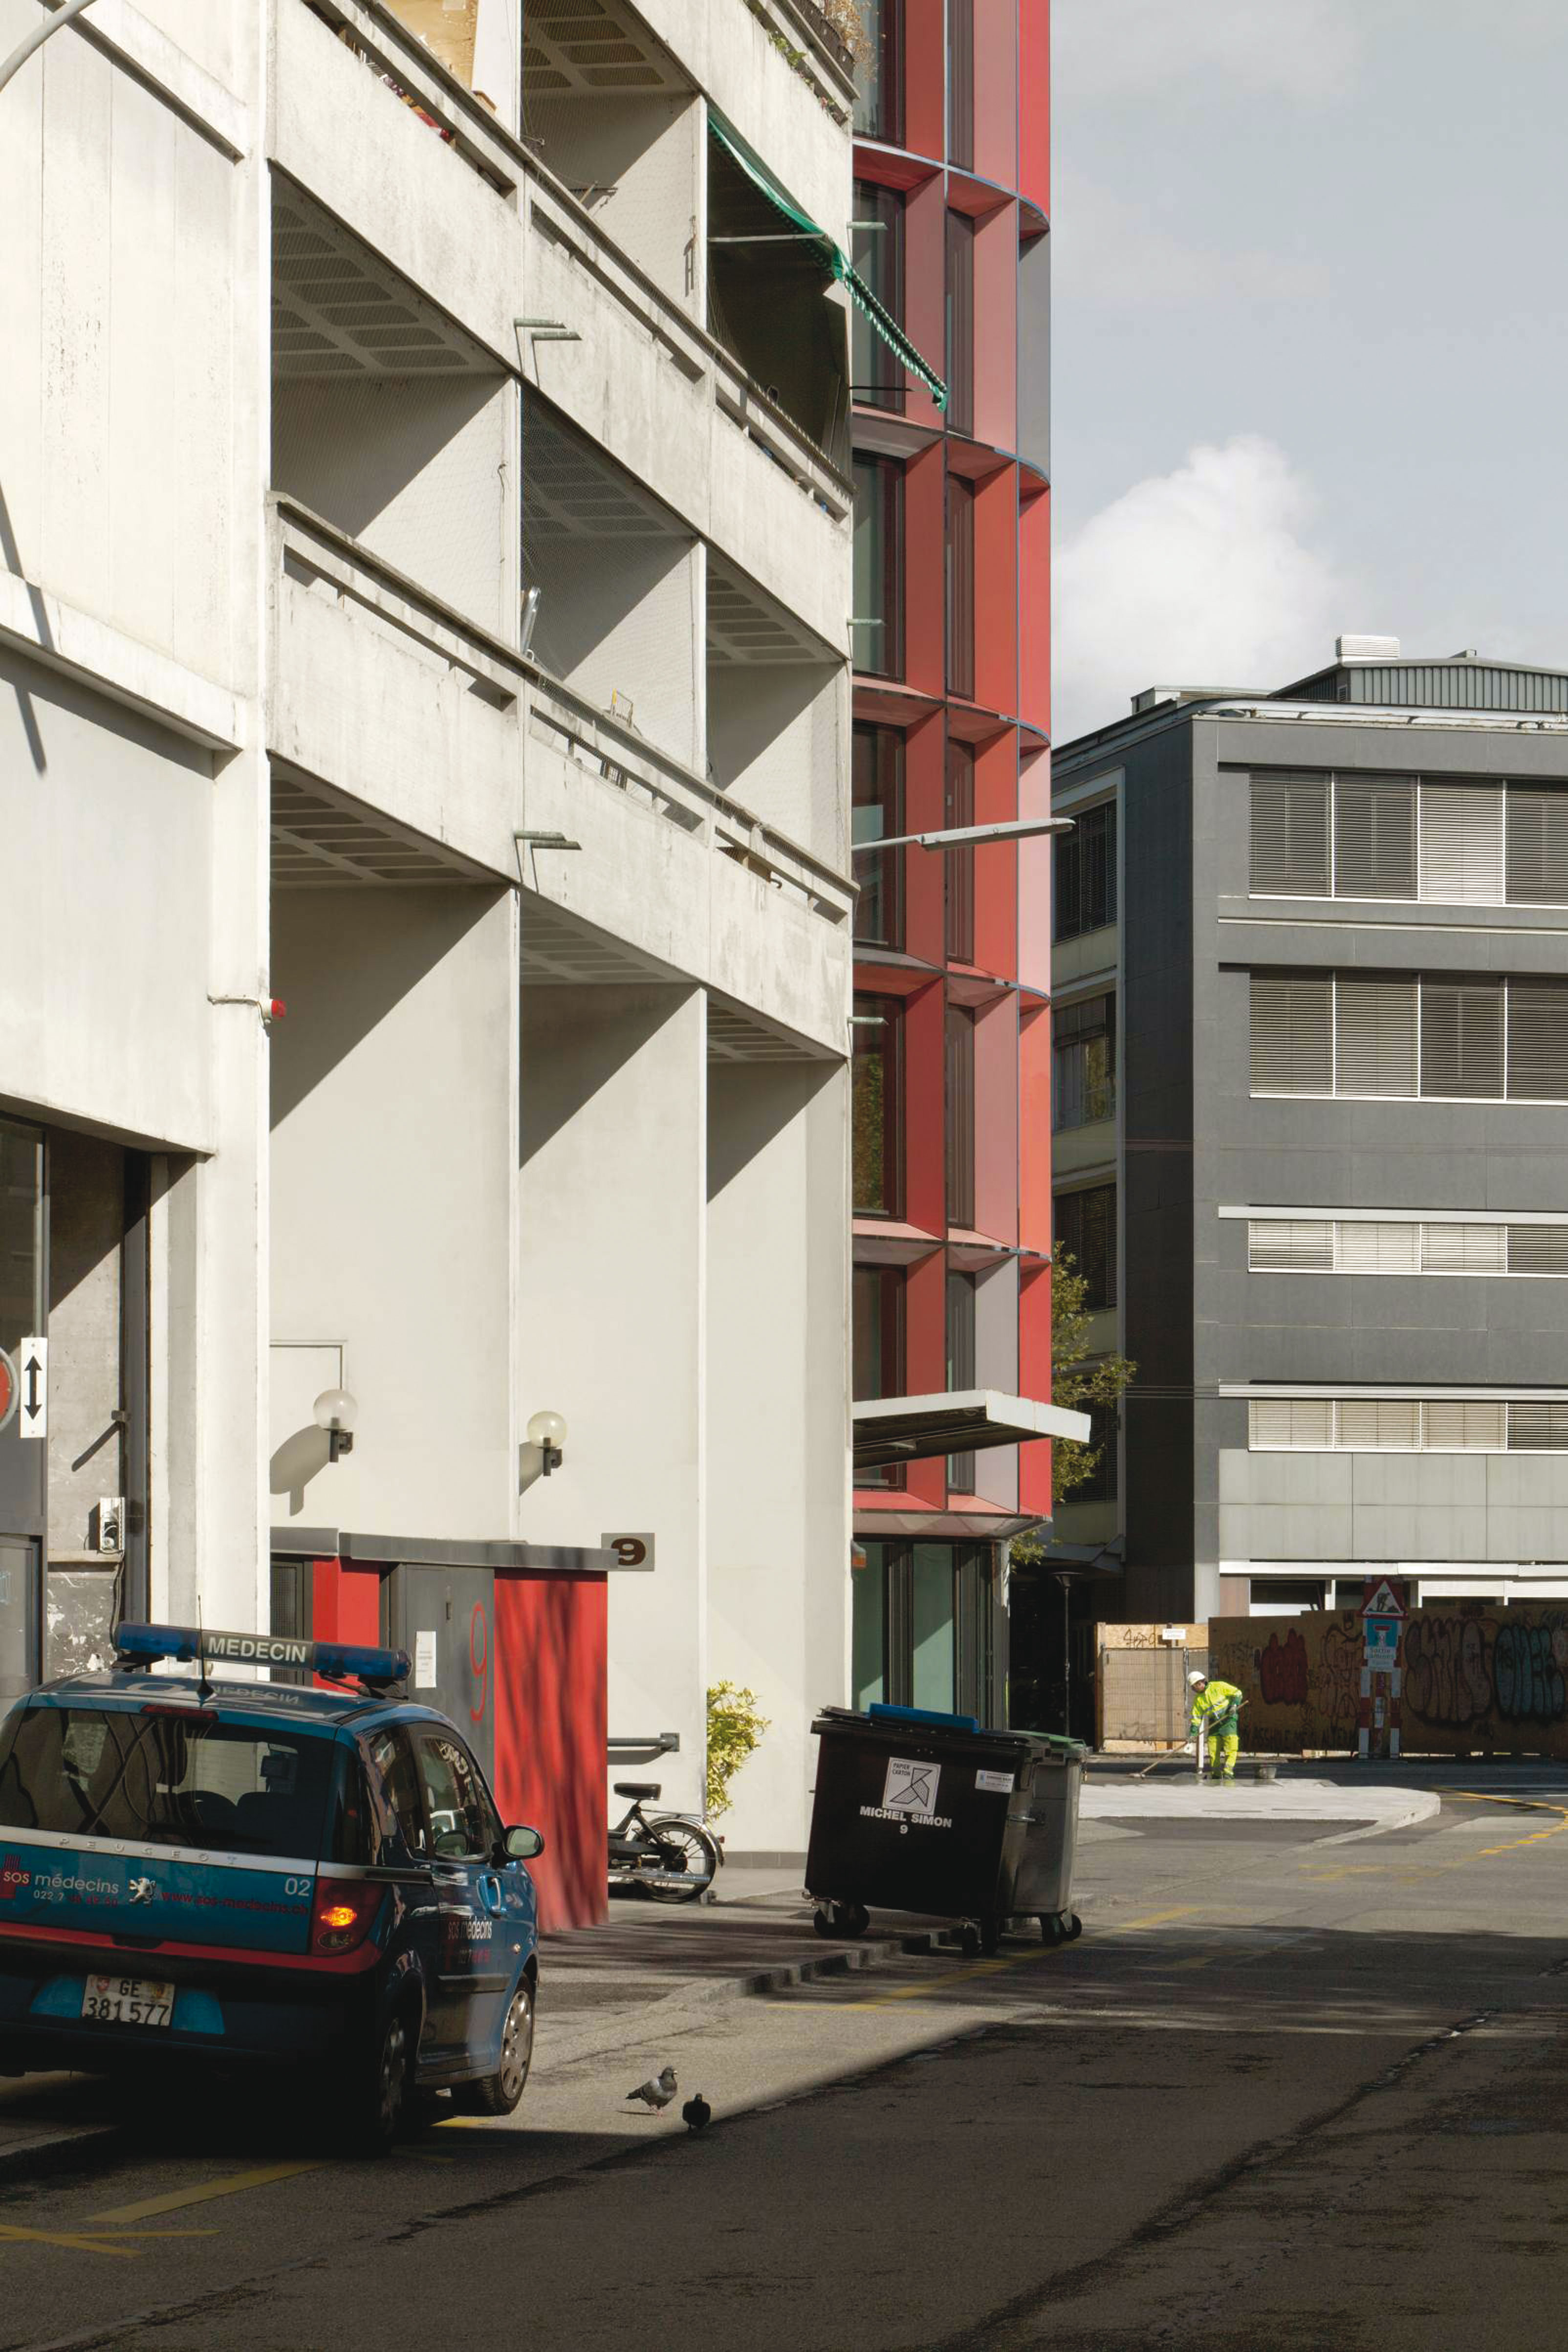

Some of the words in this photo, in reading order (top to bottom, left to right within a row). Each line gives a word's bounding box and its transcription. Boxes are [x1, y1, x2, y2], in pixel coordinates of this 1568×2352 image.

[610, 1538, 646, 1566] 9
[208, 1637, 306, 1663] MEDECIN
[860, 1806, 907, 1822] MICHEL
[911, 1814, 952, 1828] SIMON
[899, 1825, 908, 1834] 9
[59, 1836, 237, 1865] PEUGEOT
[3, 1871, 30, 1884] sos
[35, 1873, 119, 1894] médecins
[284, 1877, 311, 1896] 02
[33, 1890, 53, 1901] 022
[119, 1980, 142, 1998] GE
